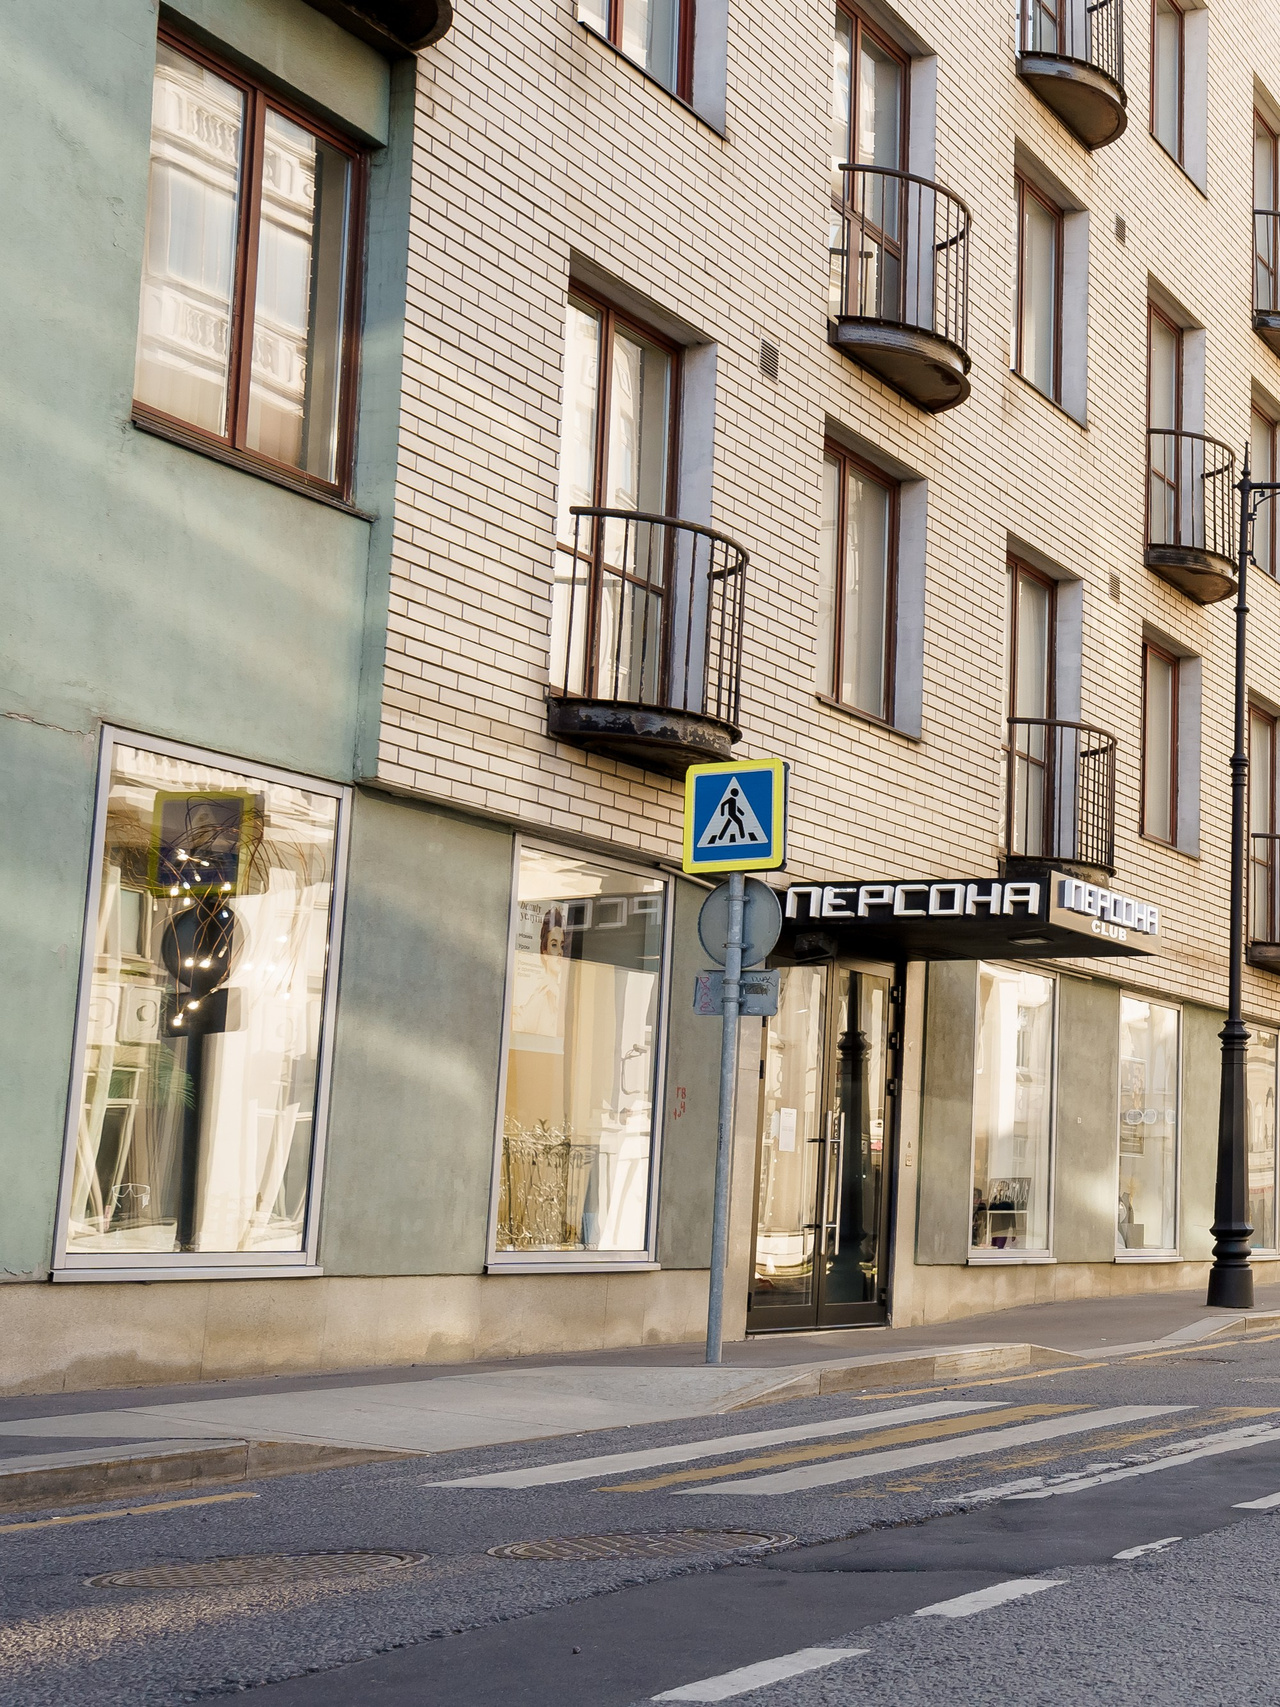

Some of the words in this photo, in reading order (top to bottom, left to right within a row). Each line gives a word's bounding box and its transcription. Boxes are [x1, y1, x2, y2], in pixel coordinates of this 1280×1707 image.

[785, 882, 1040, 919] ПЕРСОНА
[1064, 879, 1159, 935] ПЕРСОНА
[1091, 920, 1127, 941] CLUB
